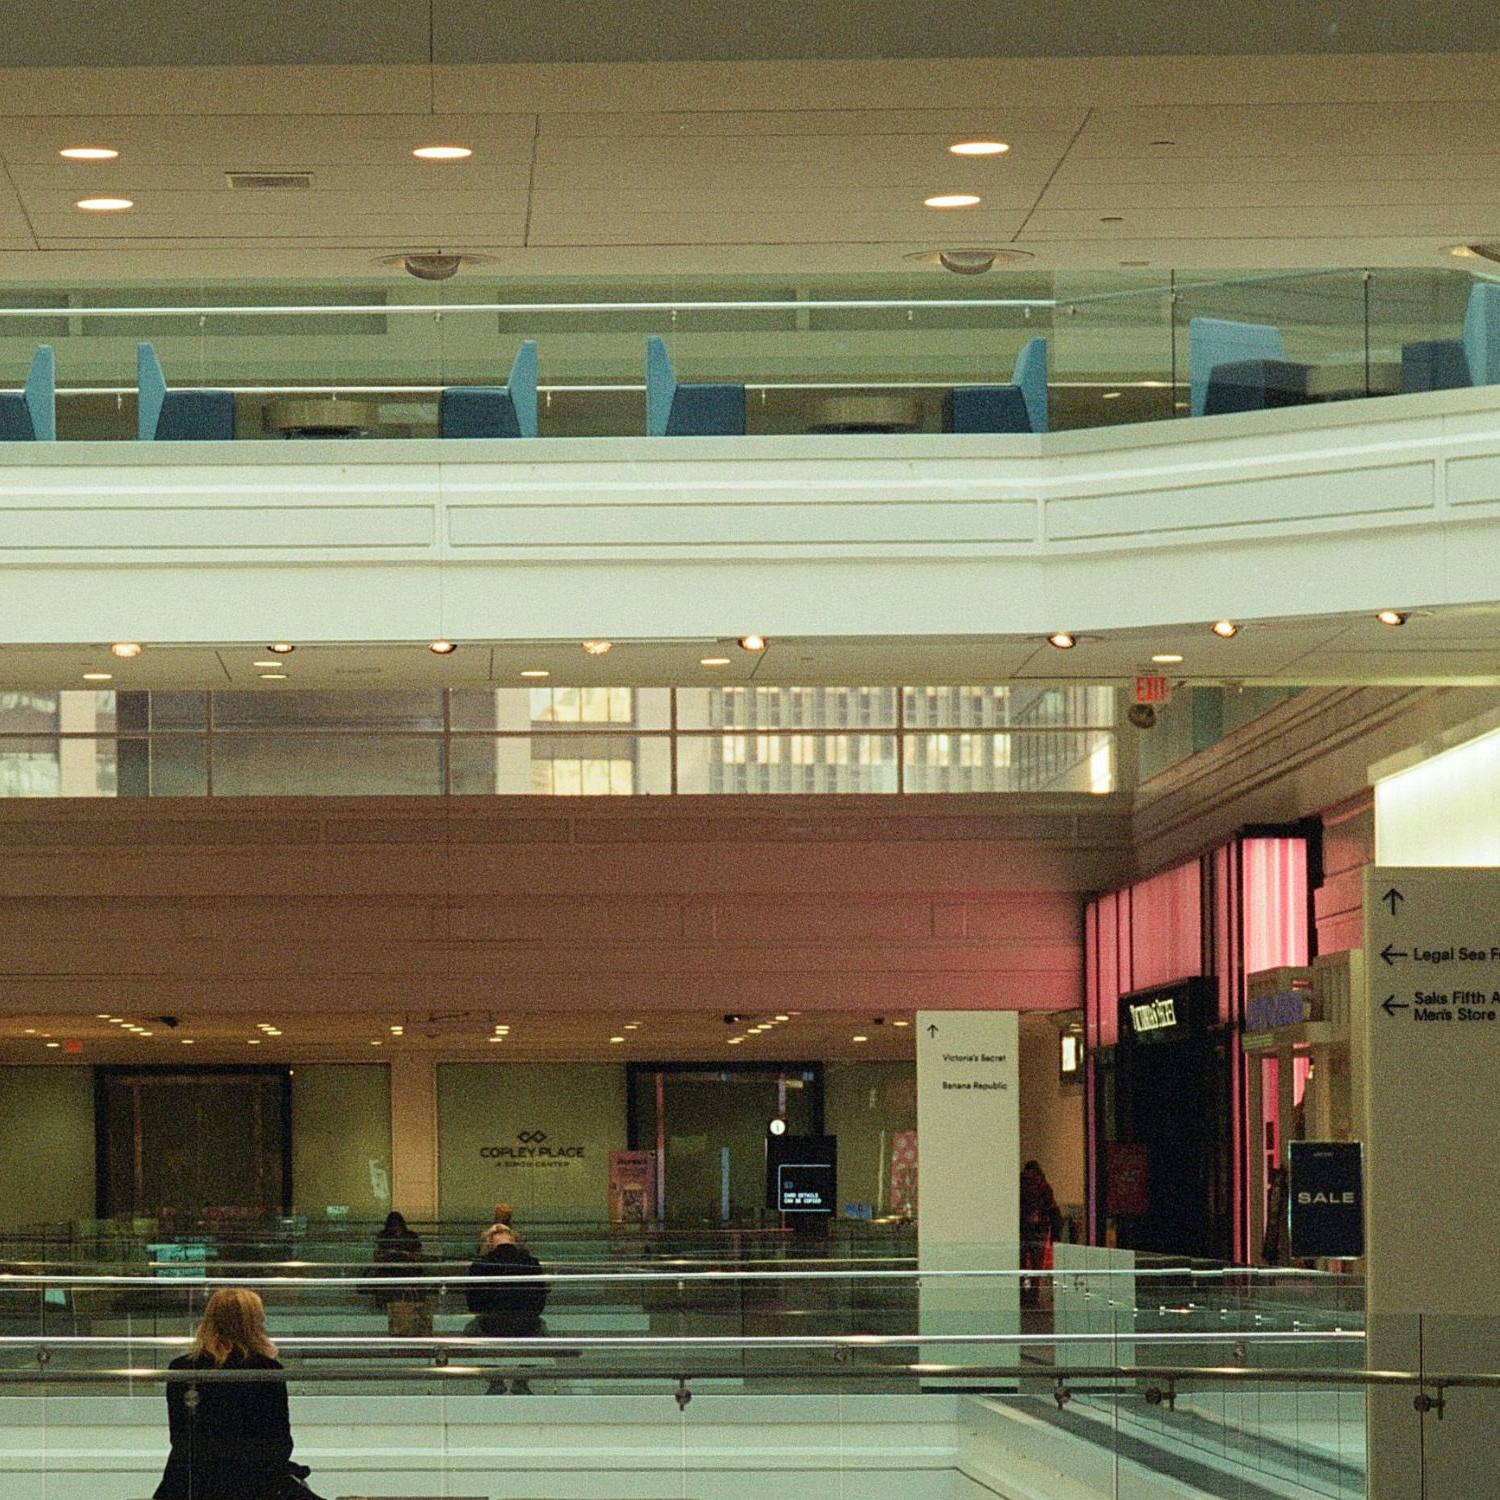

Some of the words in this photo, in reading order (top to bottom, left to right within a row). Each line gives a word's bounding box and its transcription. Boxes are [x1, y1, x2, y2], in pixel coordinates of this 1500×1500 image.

[1136, 676, 1167, 702] EXIT
[1414, 947, 1455, 964] Legal
[1459, 947, 1486, 961] Sea
[1414, 991, 1449, 1005] Saks
[1453, 990, 1486, 1005] Fifth
[1413, 1008, 1453, 1021] Men's
[1458, 1007, 1496, 1021] Store
[942, 1053, 979, 1062] Victoria's
[981, 1053, 1006, 1062] Secret
[942, 1081, 971, 1090] Banana
[973, 1081, 1008, 1091] Republic
[480, 1147, 536, 1159] COPLEY
[538, 1147, 586, 1159] PLACE
[1297, 1191, 1355, 1204] SALE
